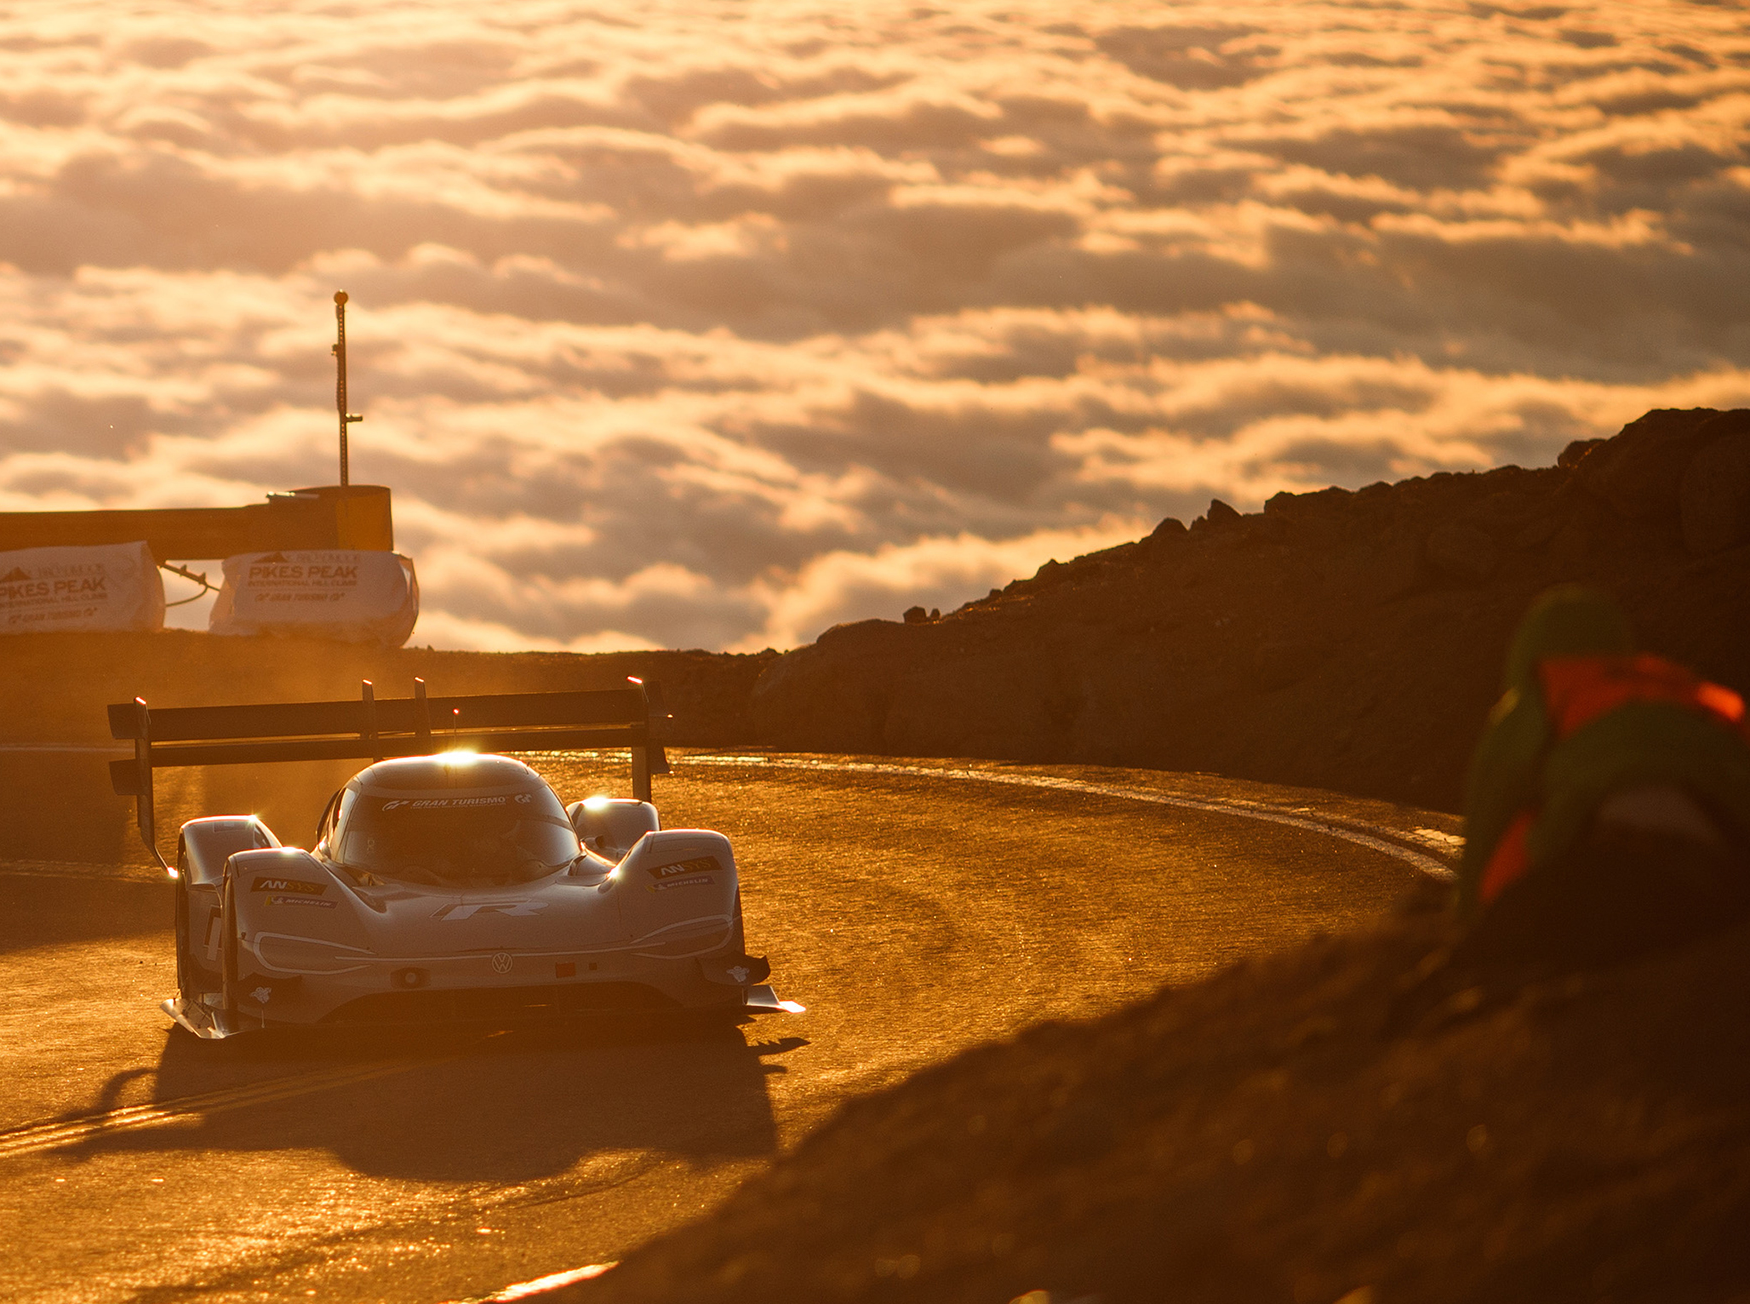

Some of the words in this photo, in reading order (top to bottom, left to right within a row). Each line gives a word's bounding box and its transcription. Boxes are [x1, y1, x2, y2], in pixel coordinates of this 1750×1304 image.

[249, 566, 303, 579] PIKES
[308, 566, 358, 578] PEAK
[54, 577, 106, 594] PEAK
[452, 796, 506, 805] TURISMO
[660, 859, 711, 876] ANSYS
[259, 880, 315, 892] ANSYS
[667, 878, 708, 888] MICHELIN
